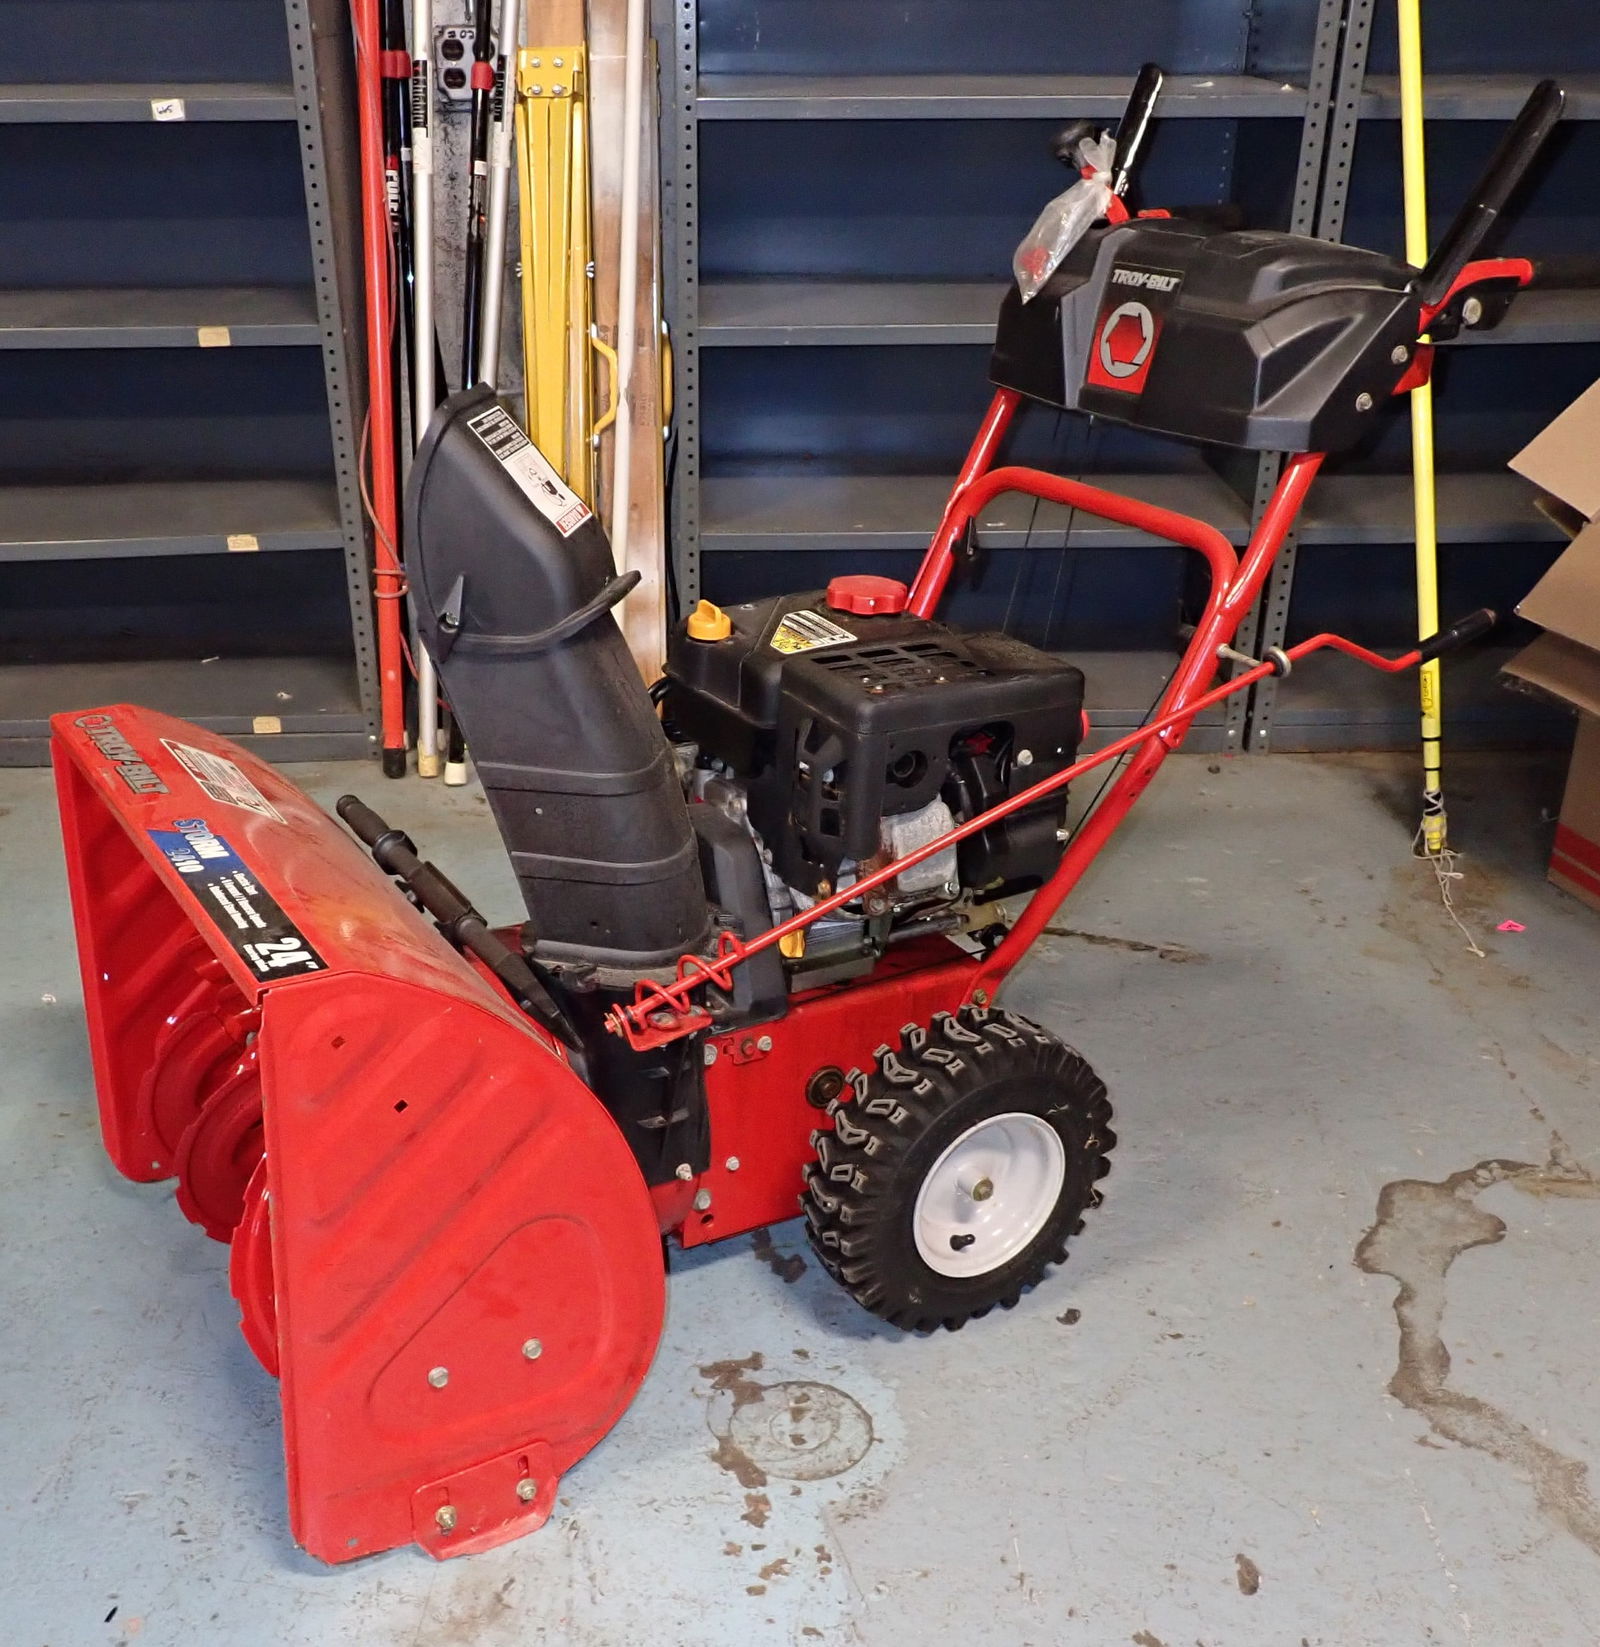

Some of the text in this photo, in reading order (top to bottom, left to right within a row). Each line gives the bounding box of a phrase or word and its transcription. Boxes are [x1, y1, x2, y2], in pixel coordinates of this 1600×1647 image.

[1111, 268, 1181, 292] TROY-BILT
[83, 724, 171, 794] TROY-BILT
[172, 818, 230, 859] STORM
[164, 848, 205, 873] 2410
